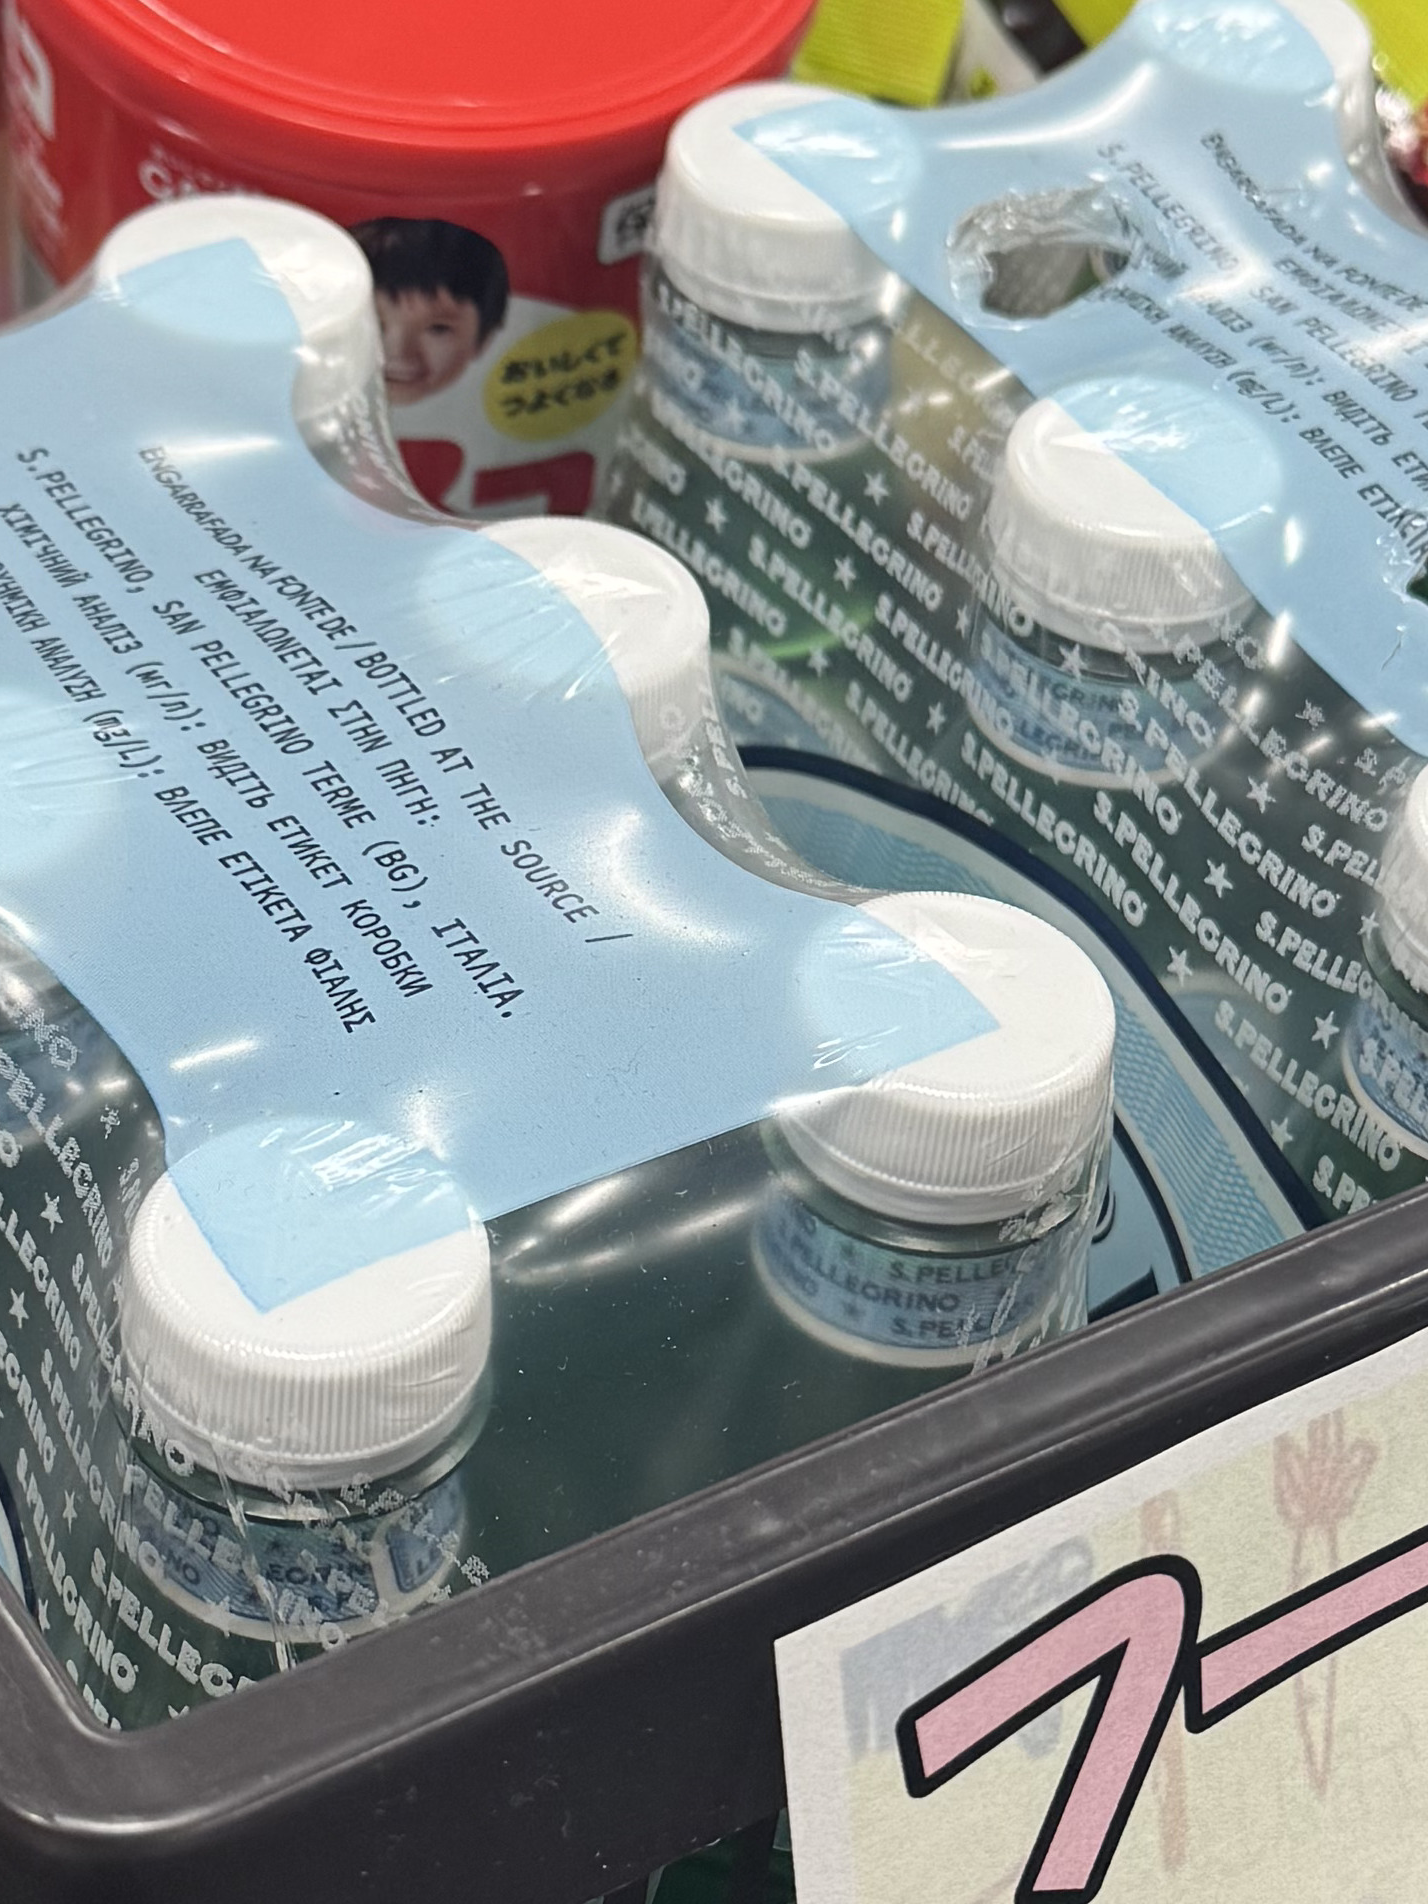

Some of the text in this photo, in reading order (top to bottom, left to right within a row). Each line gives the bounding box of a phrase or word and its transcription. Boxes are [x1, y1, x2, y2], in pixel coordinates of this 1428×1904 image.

[16, 446, 157, 595] S.PELLEGRINO,
[152, 598, 207, 636] SAN
[189, 638, 316, 757] PELLEGRINO
[301, 759, 378, 830] TERME
[361, 839, 430, 910] (BG),
[138, 444, 253, 558] ENGARRAFADA
[244, 553, 282, 585] NA
[268, 570, 335, 624] FONTE
[353, 650, 447, 739] BOTTLED
[429, 745, 475, 776] AT
[459, 781, 512, 832] THE
[499, 837, 601, 925] SOURCE
[748, 533, 914, 703] S.PELLEGRINO
[960, 731, 1152, 928] S.PELLEGRINO
[1172, 632, 1392, 833] PELLEGRINO
[1091, 789, 1293, 1015] S.PELLEGRINO
[1213, 998, 1405, 1174] S.PELLEGRINO
[15, 1446, 140, 1695] S.PELLEGRINO
